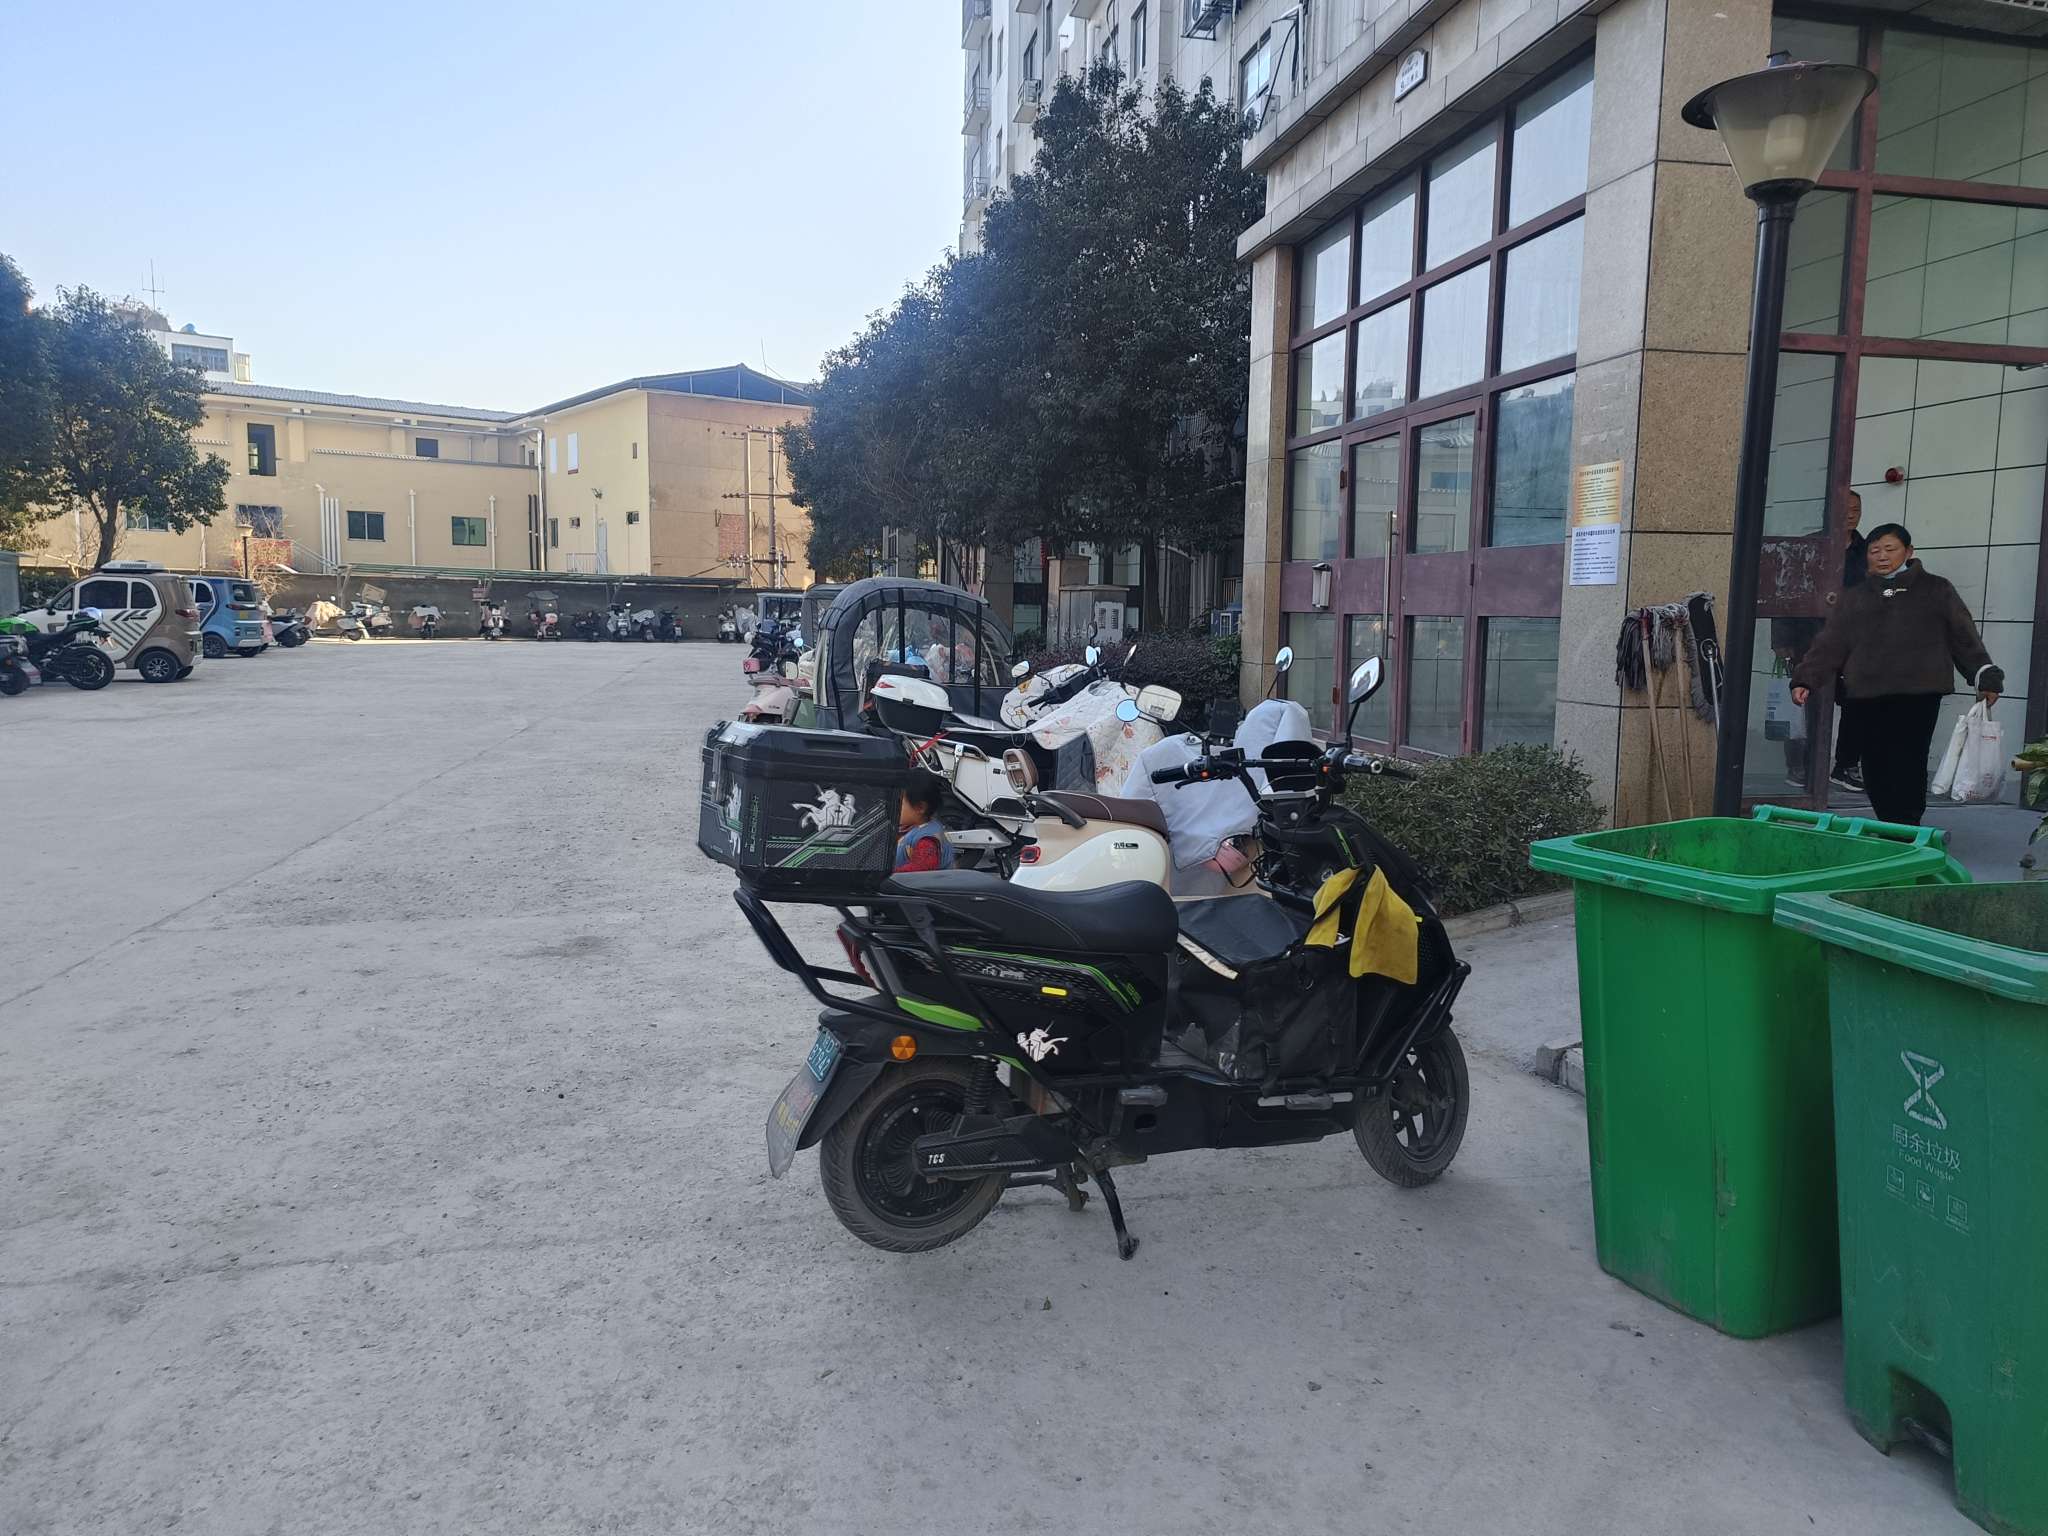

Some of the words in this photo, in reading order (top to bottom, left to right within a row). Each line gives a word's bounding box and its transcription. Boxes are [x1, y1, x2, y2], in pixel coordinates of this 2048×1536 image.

[1892, 1123, 1961, 1173] 厨余垃圾
[1899, 1148, 1922, 1168] Food
